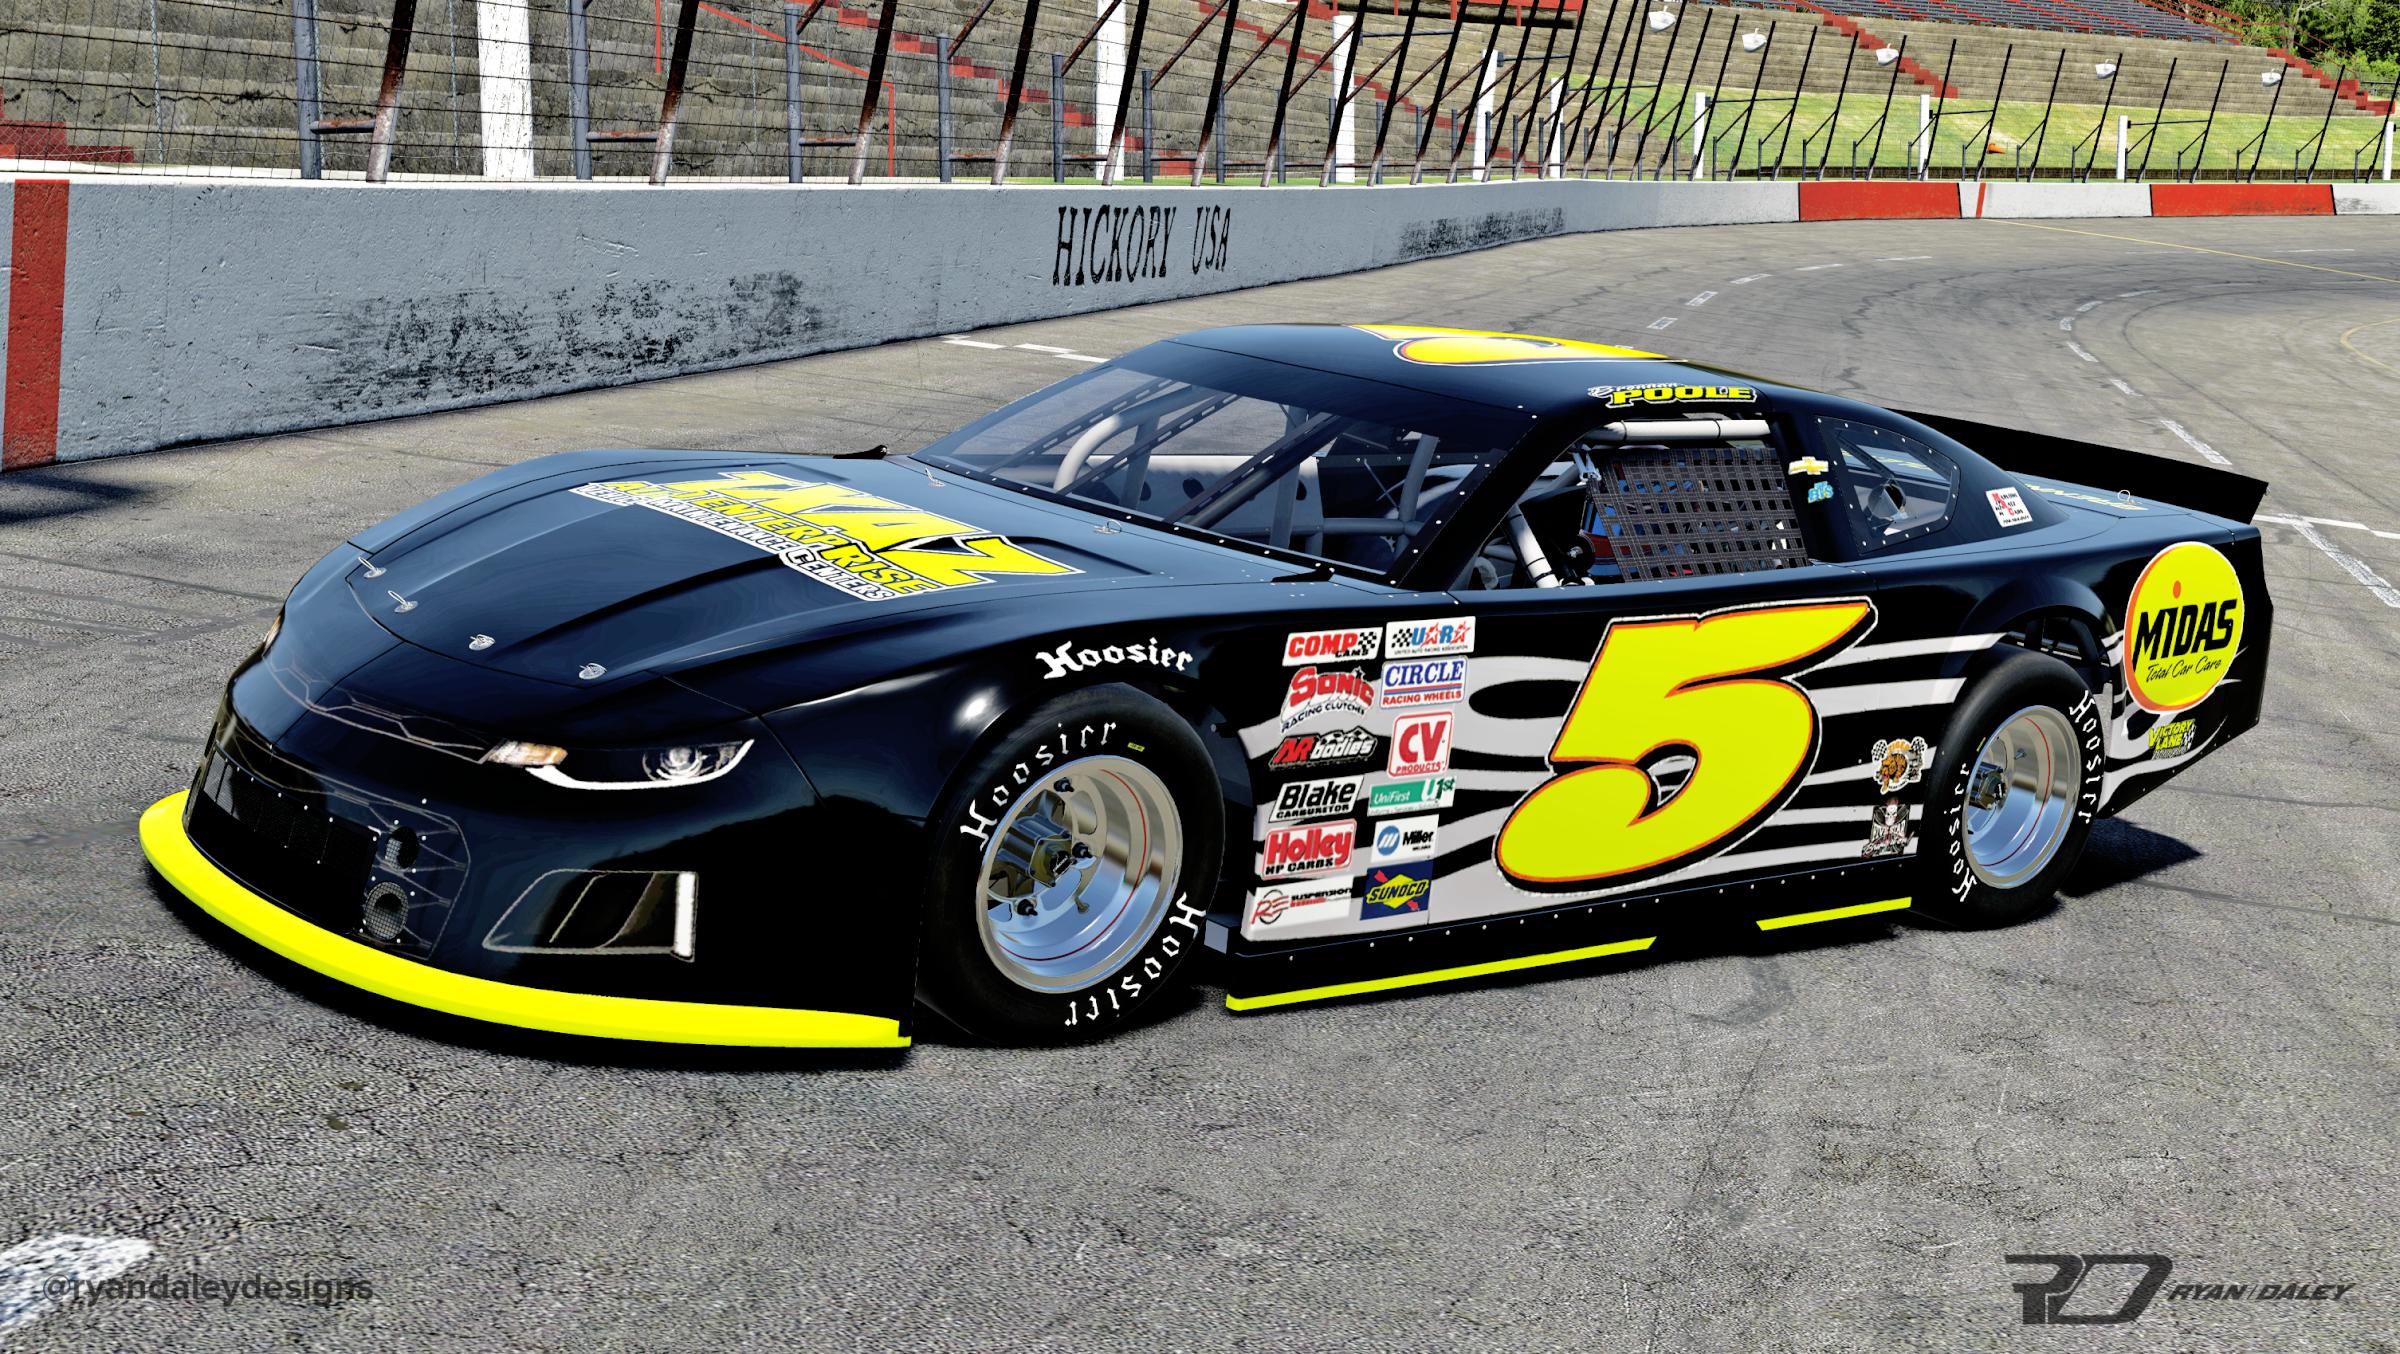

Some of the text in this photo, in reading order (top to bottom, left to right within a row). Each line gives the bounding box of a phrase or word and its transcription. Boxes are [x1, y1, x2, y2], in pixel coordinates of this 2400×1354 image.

[1052, 204, 1231, 286] HICKORY USA
[1612, 386, 1752, 405] POOLE
[691, 497, 940, 594] ENTERPRISE
[786, 548, 897, 600] CENTERS
[1288, 632, 1359, 659] COMP
[2132, 598, 2238, 673] MIDAS
[1036, 636, 1194, 681] Hoosier
[1334, 648, 1370, 659] CAMS
[1384, 659, 1465, 687] CIRCLE
[2145, 655, 2222, 683] Total Car Care
[1382, 690, 1463, 705] RACING WHEELS
[1281, 705, 1323, 734] RACING
[2149, 720, 2194, 747] VICTORY
[1398, 720, 1448, 764] CV
[1495, 597, 1876, 895] 5
[2155, 733, 2183, 750] LANE
[1395, 761, 1442, 774] PRODUCTS
[2068, 689, 2103, 825] Hoosier
[960, 722, 1117, 851] Hoosier
[1278, 778, 1357, 811] Blake
[1373, 790, 1411, 806] UniFirst
[1266, 825, 1354, 866] Holley
[1402, 829, 1434, 846] Miller
[1265, 858, 1334, 876] HP CARBS
[1368, 880, 1429, 902] SUNOCO
[1064, 891, 1207, 1028] Hoosier
